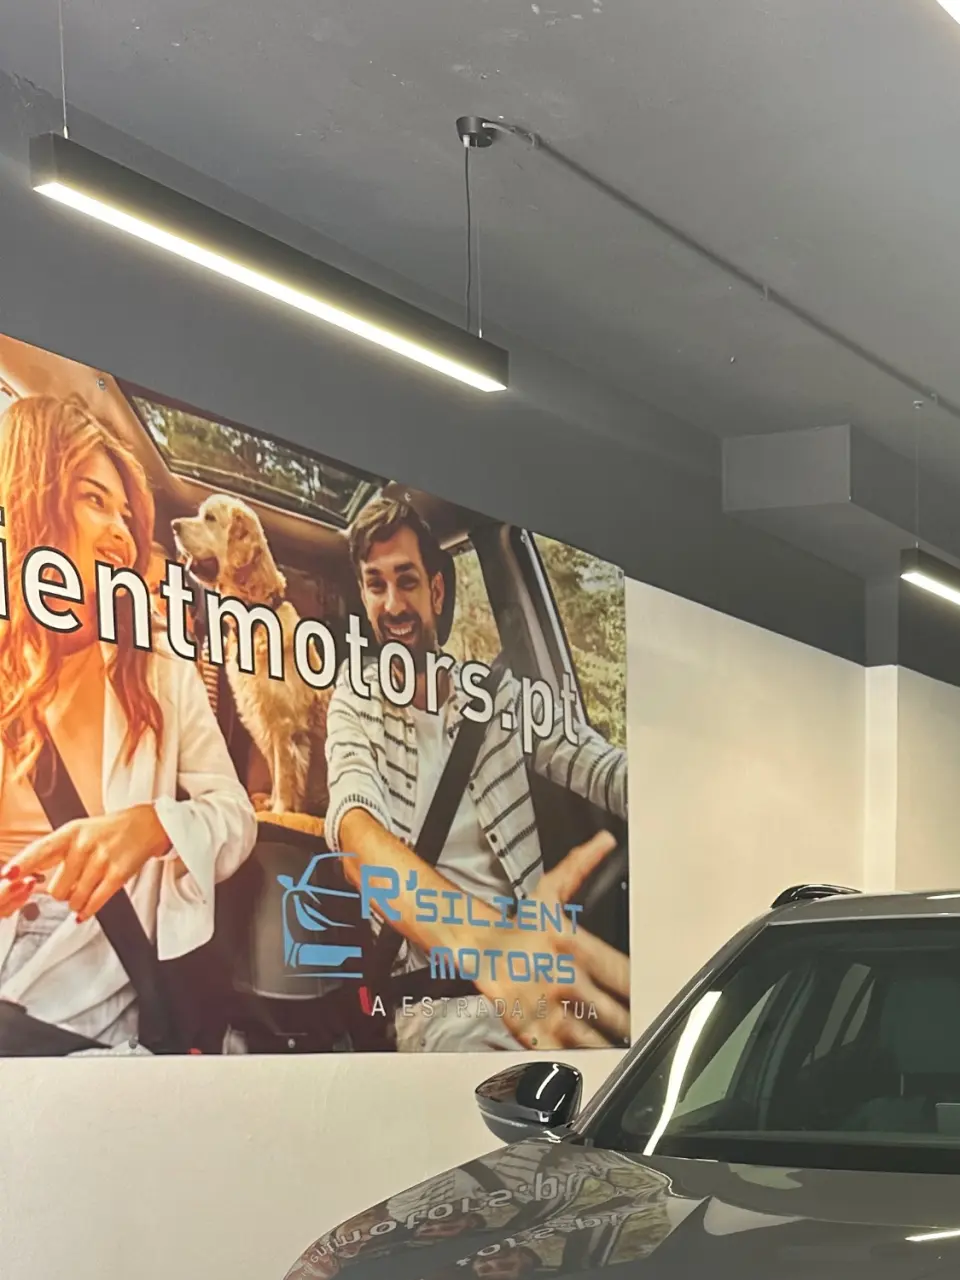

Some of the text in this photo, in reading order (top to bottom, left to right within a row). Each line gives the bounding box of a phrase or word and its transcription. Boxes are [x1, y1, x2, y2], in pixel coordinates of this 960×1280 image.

[360, 864, 583, 934] R'SILIENT
[430, 946, 576, 984] MOTORS
[371, 994, 598, 1020] A ESTRADA É TUA
